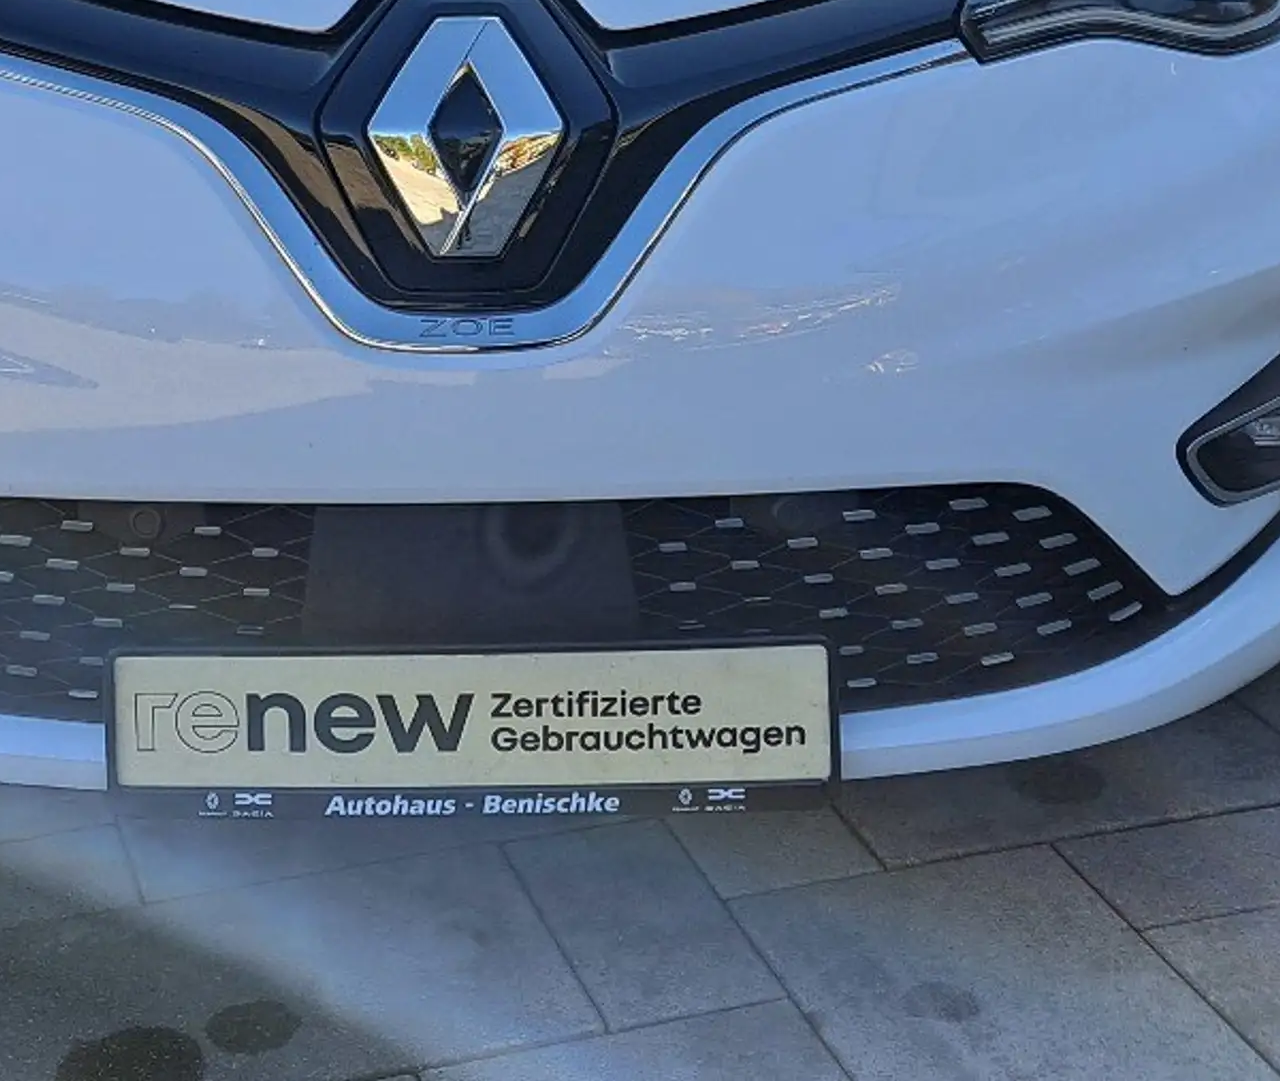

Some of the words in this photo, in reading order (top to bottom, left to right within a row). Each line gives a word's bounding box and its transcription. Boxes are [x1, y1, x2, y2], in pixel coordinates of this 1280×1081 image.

[419, 317, 516, 338] ZOE
[490, 689, 703, 719] Zertifizierte
[133, 690, 475, 754] renew
[490, 722, 807, 756] Gebrauchtwagen
[324, 794, 457, 816] Autohaus
[482, 791, 620, 814] Benischke
